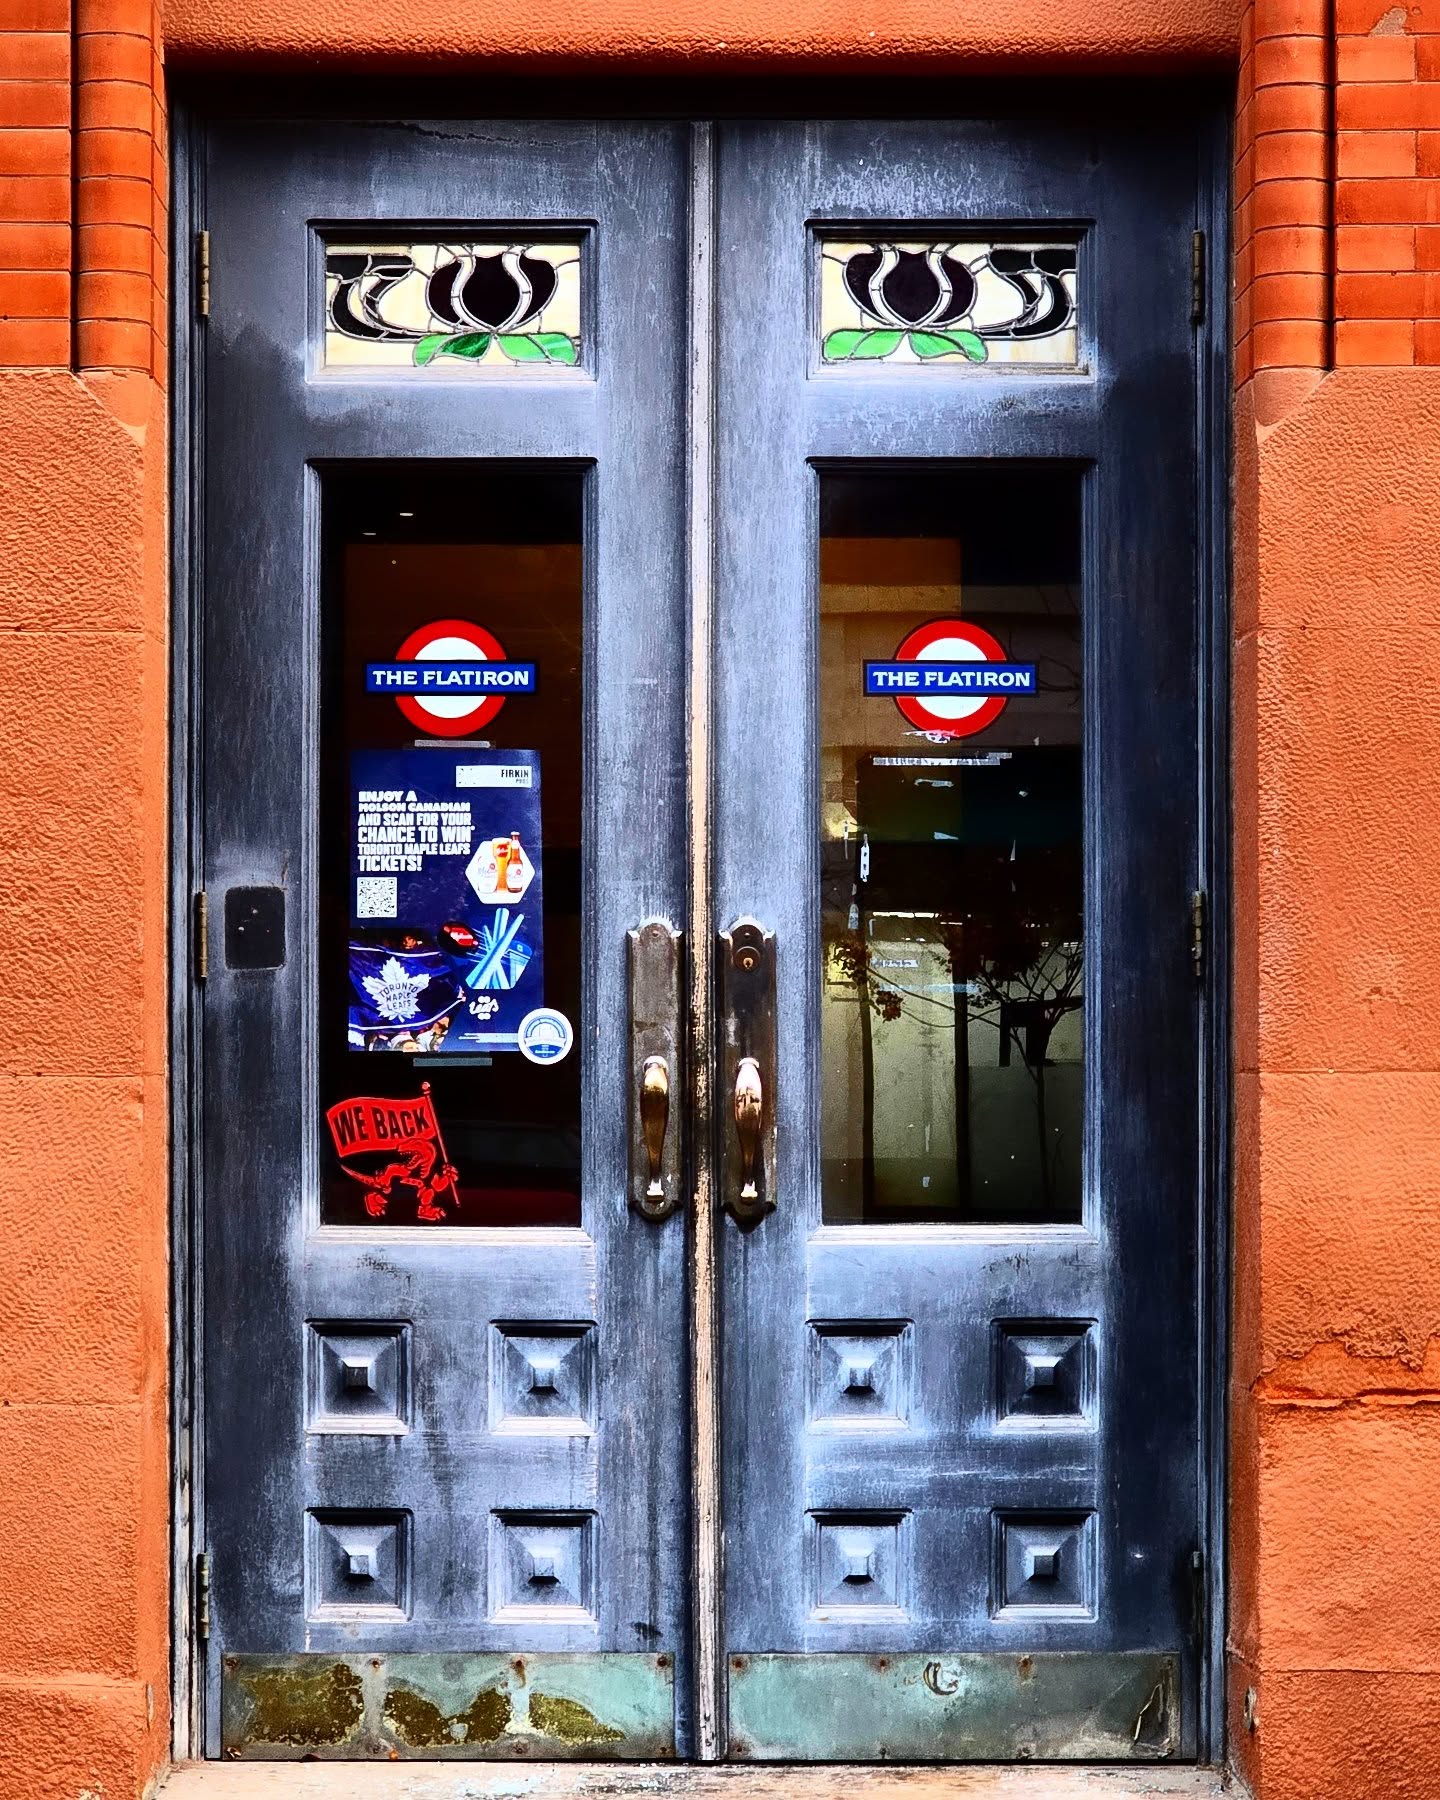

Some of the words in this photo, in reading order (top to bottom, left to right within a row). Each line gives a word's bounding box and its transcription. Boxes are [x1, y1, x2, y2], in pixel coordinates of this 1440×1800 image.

[372, 670, 418, 686] THE
[423, 670, 529, 686] FLATIRON
[872, 671, 920, 687] THE
[924, 671, 1031, 687] FLATIRON
[501, 769, 529, 778] FIRKIN
[358, 791, 404, 802] ENJOY
[406, 790, 418, 802] A
[358, 803, 406, 812] MOLSON
[408, 802, 471, 812] CANADIAN
[358, 813, 382, 826] AND
[382, 813, 414, 826] SCAN
[416, 813, 439, 826] FOR
[441, 813, 472, 826] YOUR
[357, 826, 416, 843] CHANCE
[418, 826, 438, 843] TO
[357, 843, 402, 855] TORONTO
[403, 843, 438, 855] MAPLE
[439, 843, 471, 855] LEAFS
[357, 855, 423, 872] TICKETS!
[379, 981, 419, 998] TORONTO
[385, 992, 412, 1002] MAPLE
[386, 999, 412, 1011] LEAFS
[333, 1106, 369, 1148] WE
[371, 1106, 431, 1140] BACK
